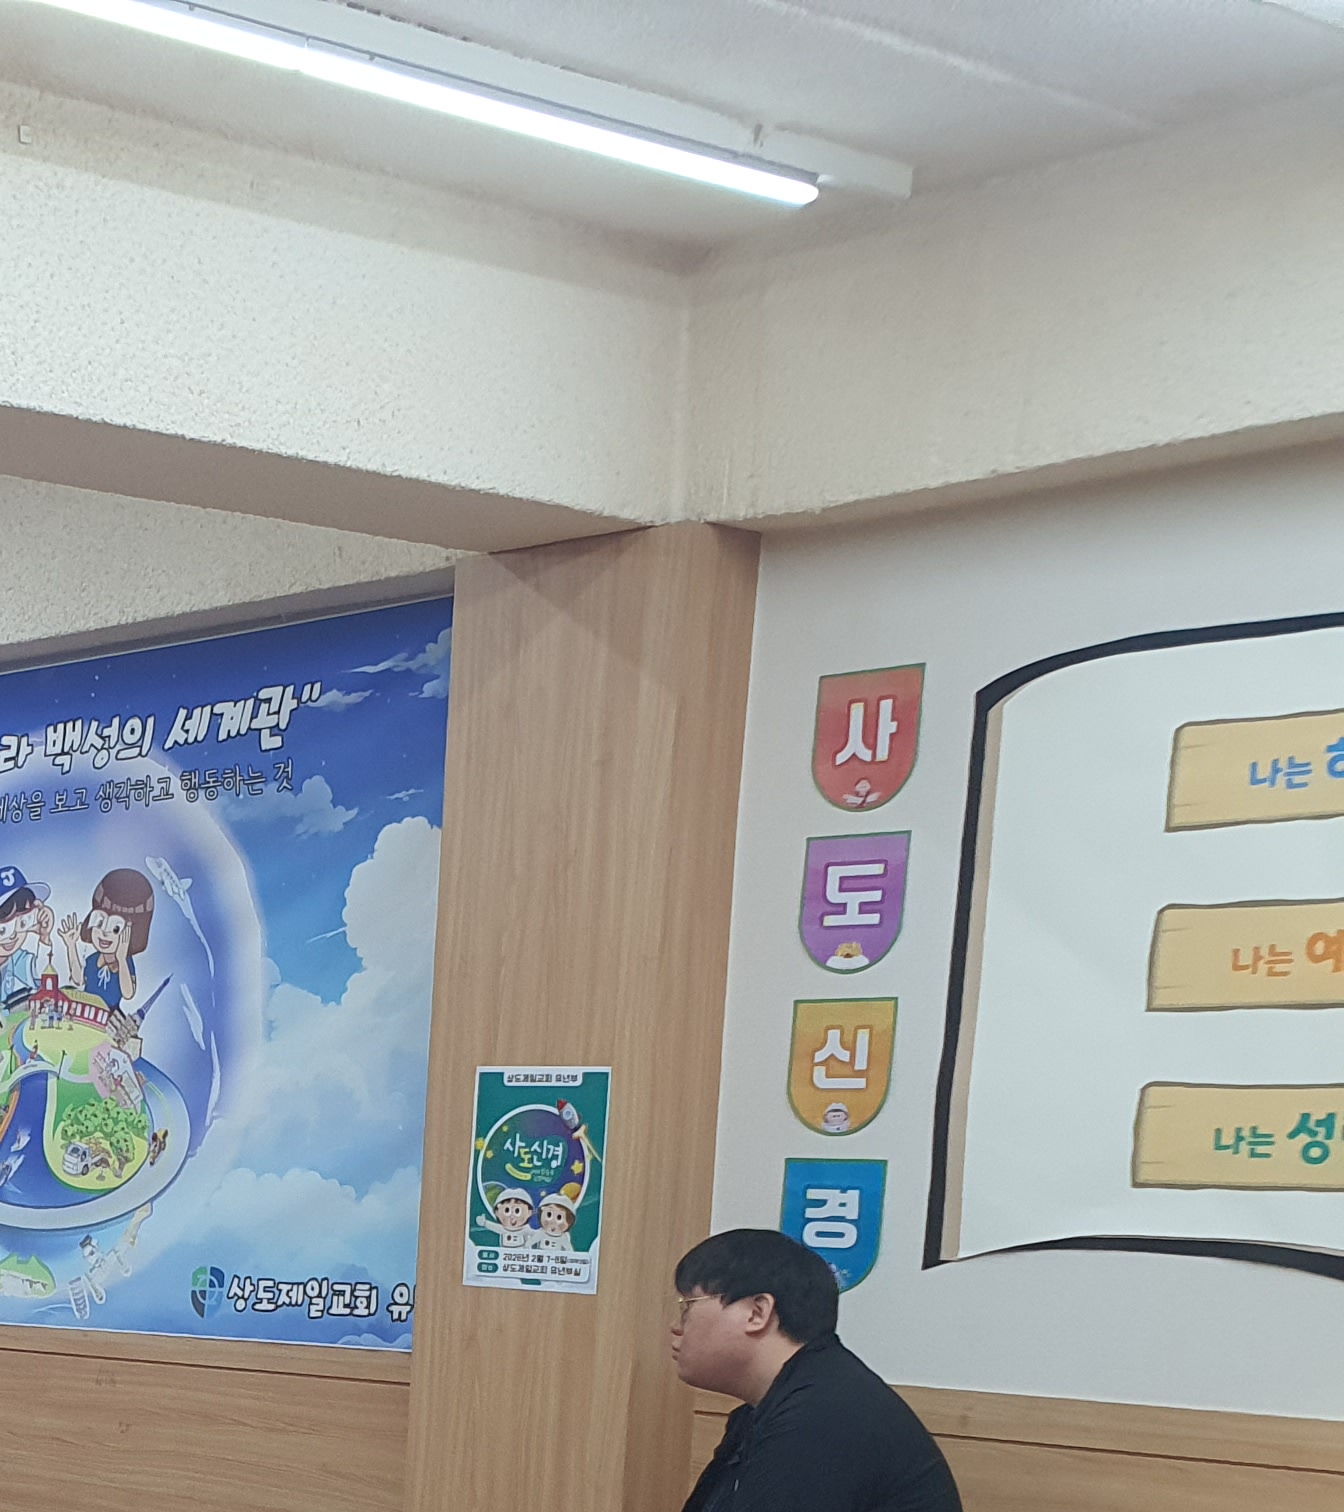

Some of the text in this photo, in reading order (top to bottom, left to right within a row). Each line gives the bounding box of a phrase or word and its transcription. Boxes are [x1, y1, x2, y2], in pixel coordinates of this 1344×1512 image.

[43, 716, 155, 774] 백성의
[165, 681, 323, 752] 세계관"
[835, 698, 898, 767] 사
[49, 785, 91, 814] 보고
[94, 773, 175, 811] 생각하고
[179, 764, 267, 803] 행동하는
[273, 758, 295, 792] 것
[1249, 755, 1313, 790] 나는
[822, 863, 886, 928] 도
[1231, 943, 1294, 978] 나는
[813, 1027, 871, 1090] 신
[503, 1133, 563, 1169] 사도신경
[1214, 1111, 1344, 1166] 나는 성
[802, 1187, 860, 1250] 경
[227, 1275, 416, 1322] 상도제일교회 유
